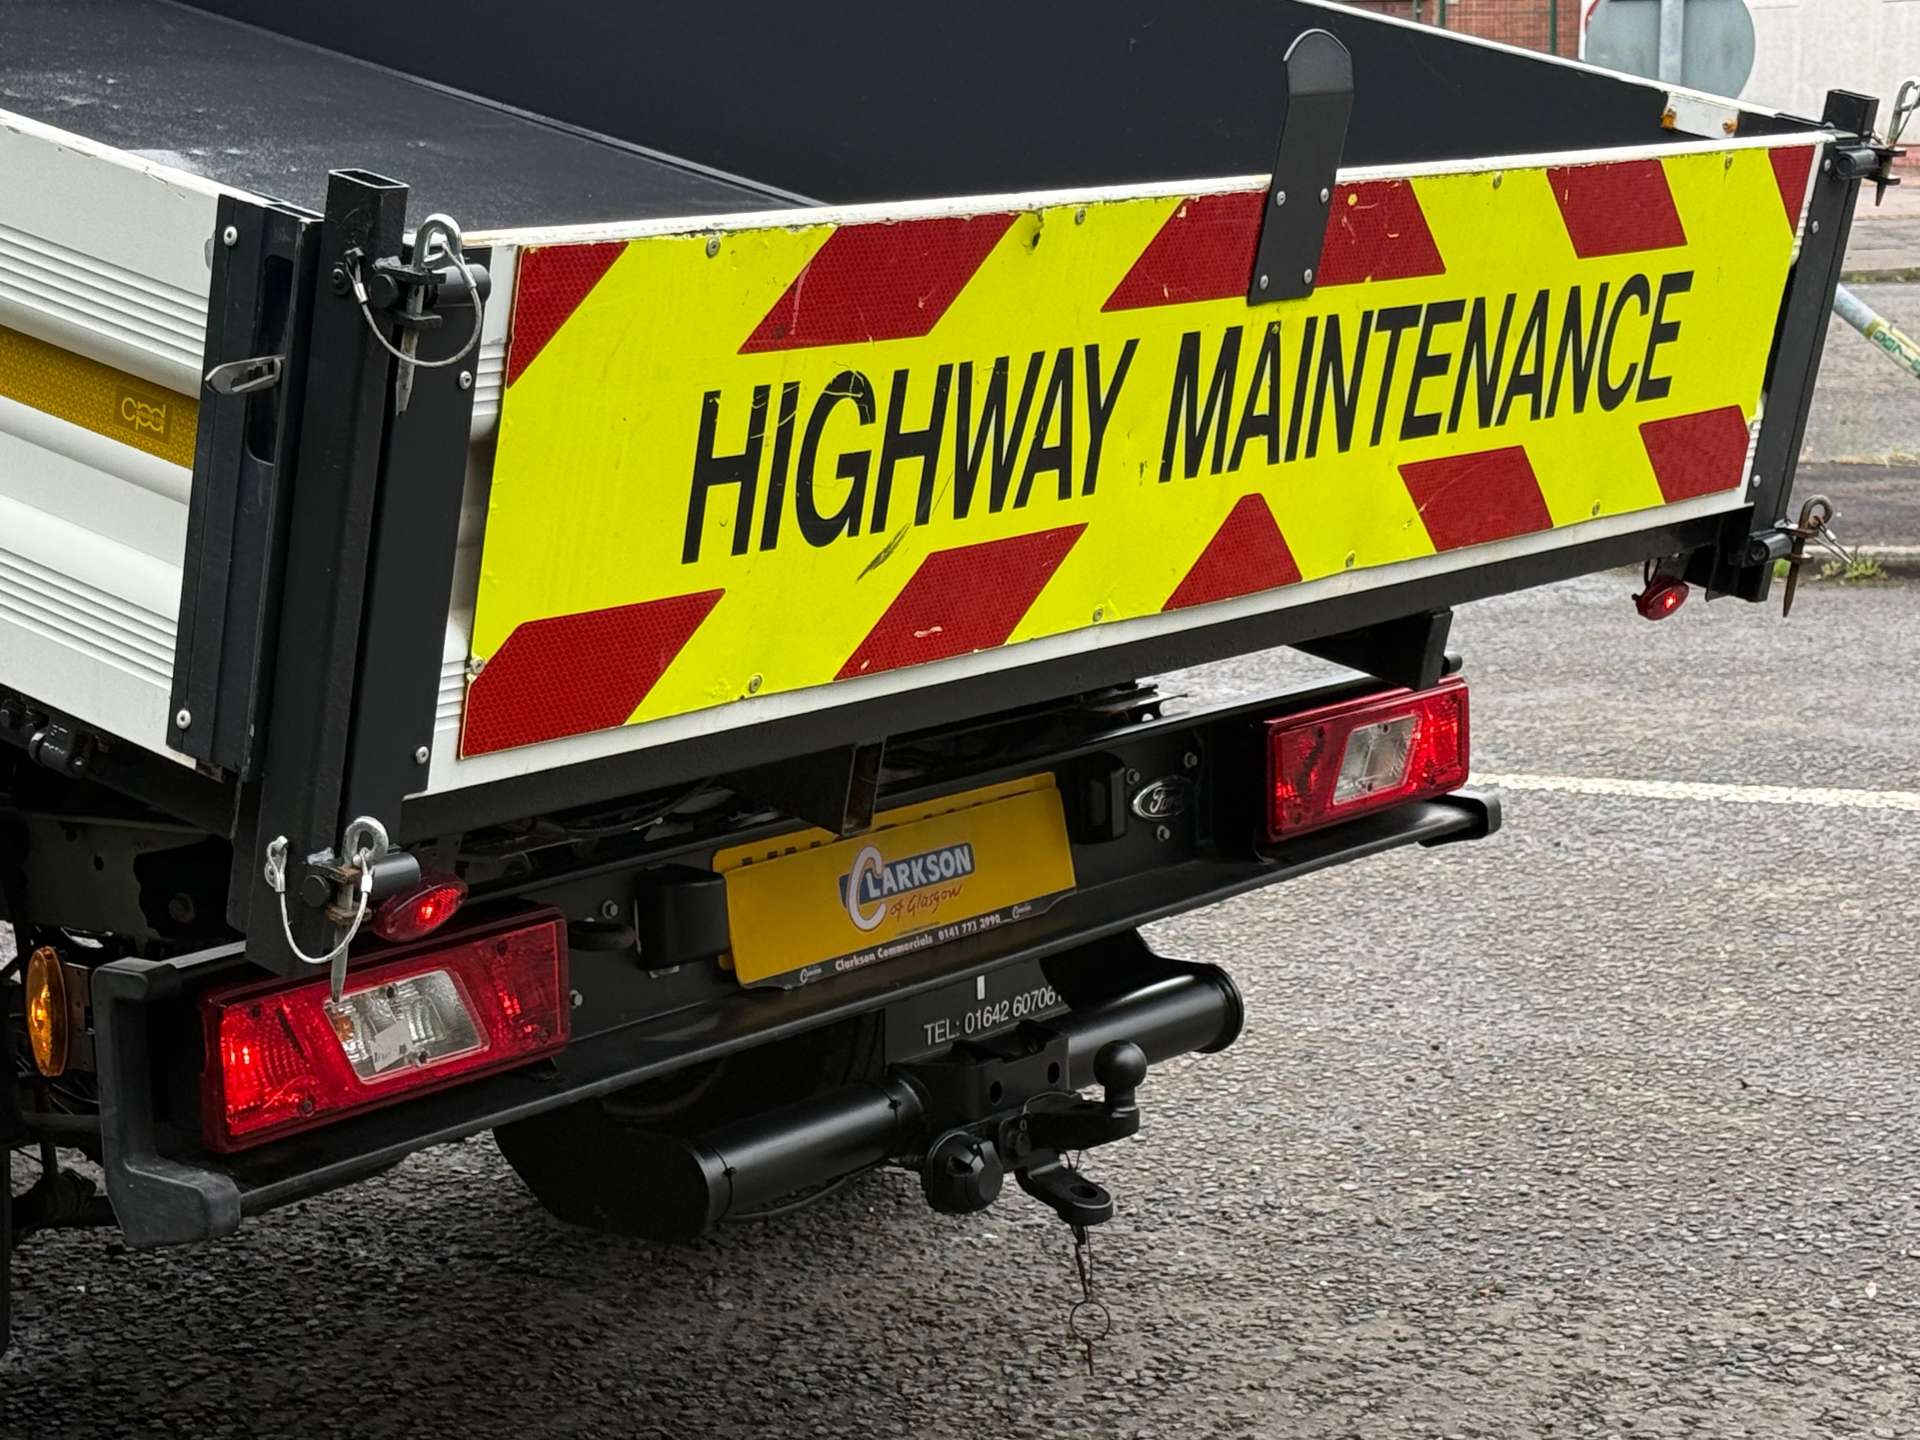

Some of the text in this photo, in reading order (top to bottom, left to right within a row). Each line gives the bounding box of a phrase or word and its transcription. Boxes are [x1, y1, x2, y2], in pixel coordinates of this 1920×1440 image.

[681, 270, 1695, 564] HIGHWAY MAINTENANCE
[846, 844, 973, 932] CLARKSON
[889, 884, 963, 921] of Glasgow
[835, 952, 876, 972] Clarkson
[877, 933, 933, 959] Commercials
[938, 925, 959, 941] 0141
[923, 1017, 961, 1046] TEL:
[964, 1000, 1010, 1034] 01642
